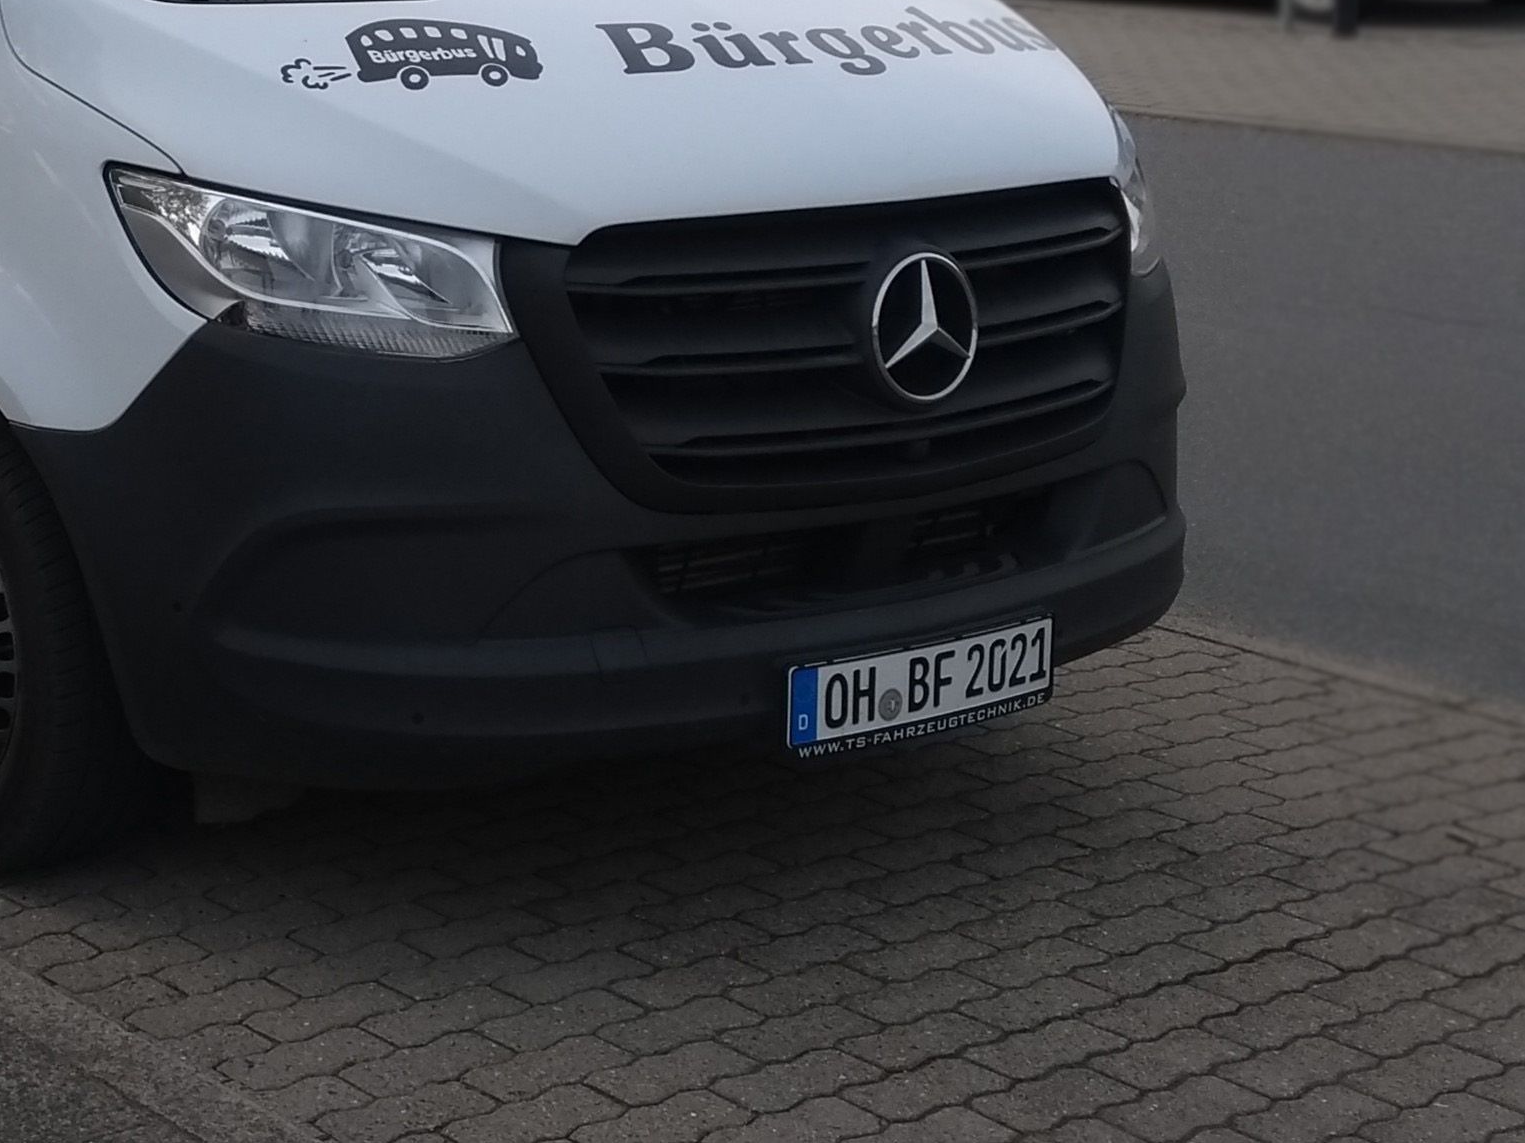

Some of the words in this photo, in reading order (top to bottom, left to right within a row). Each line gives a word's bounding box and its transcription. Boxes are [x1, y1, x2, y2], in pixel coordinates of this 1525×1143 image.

[365, 46, 478, 64] Bürgerbus
[594, 5, 1058, 76] Bürgerbus
[825, 666, 877, 730] OH
[907, 649, 957, 714] BF
[964, 626, 1047, 699] 2021
[797, 713, 810, 732] D
[798, 692, 1046, 759] WWW.TS-FAHRZEUGTECHNIK.DE
